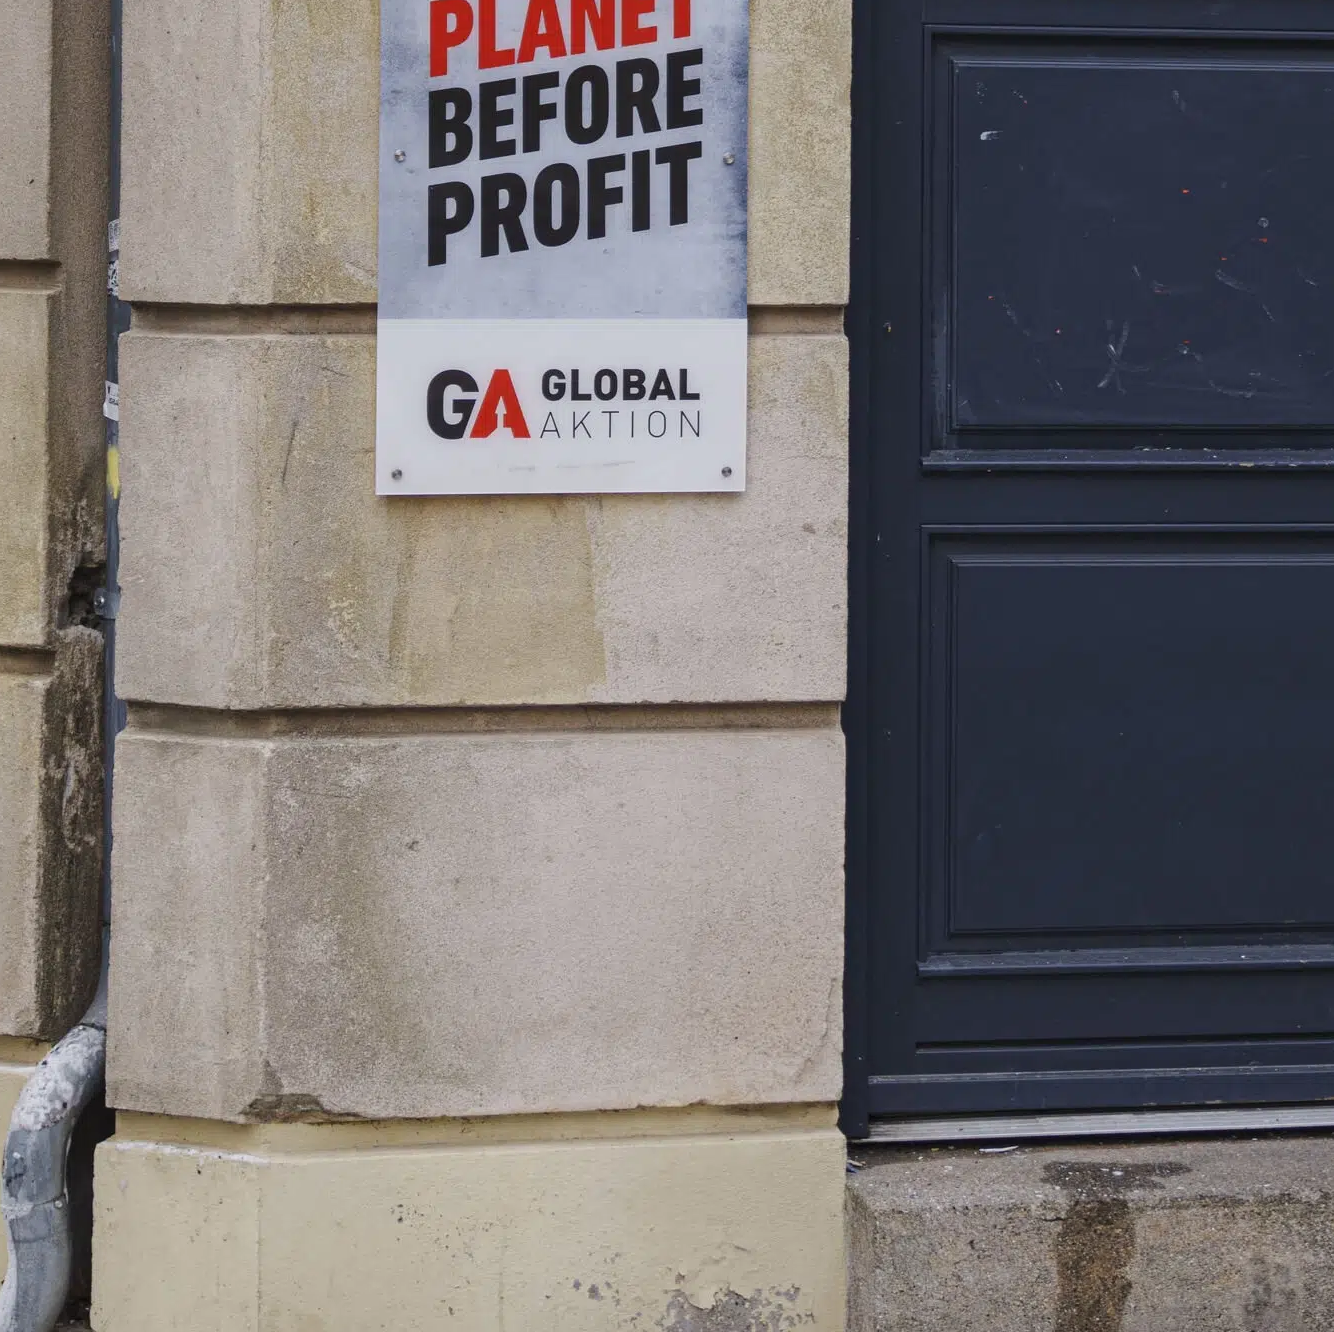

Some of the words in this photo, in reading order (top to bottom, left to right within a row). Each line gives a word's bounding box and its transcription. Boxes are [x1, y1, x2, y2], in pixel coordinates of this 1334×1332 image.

[428, 48, 703, 169] BEFORE
[427, 140, 702, 267] PROFIT
[427, 368, 531, 440] GA
[541, 369, 700, 401] GLOBAL
[539, 410, 701, 439] AKTION
